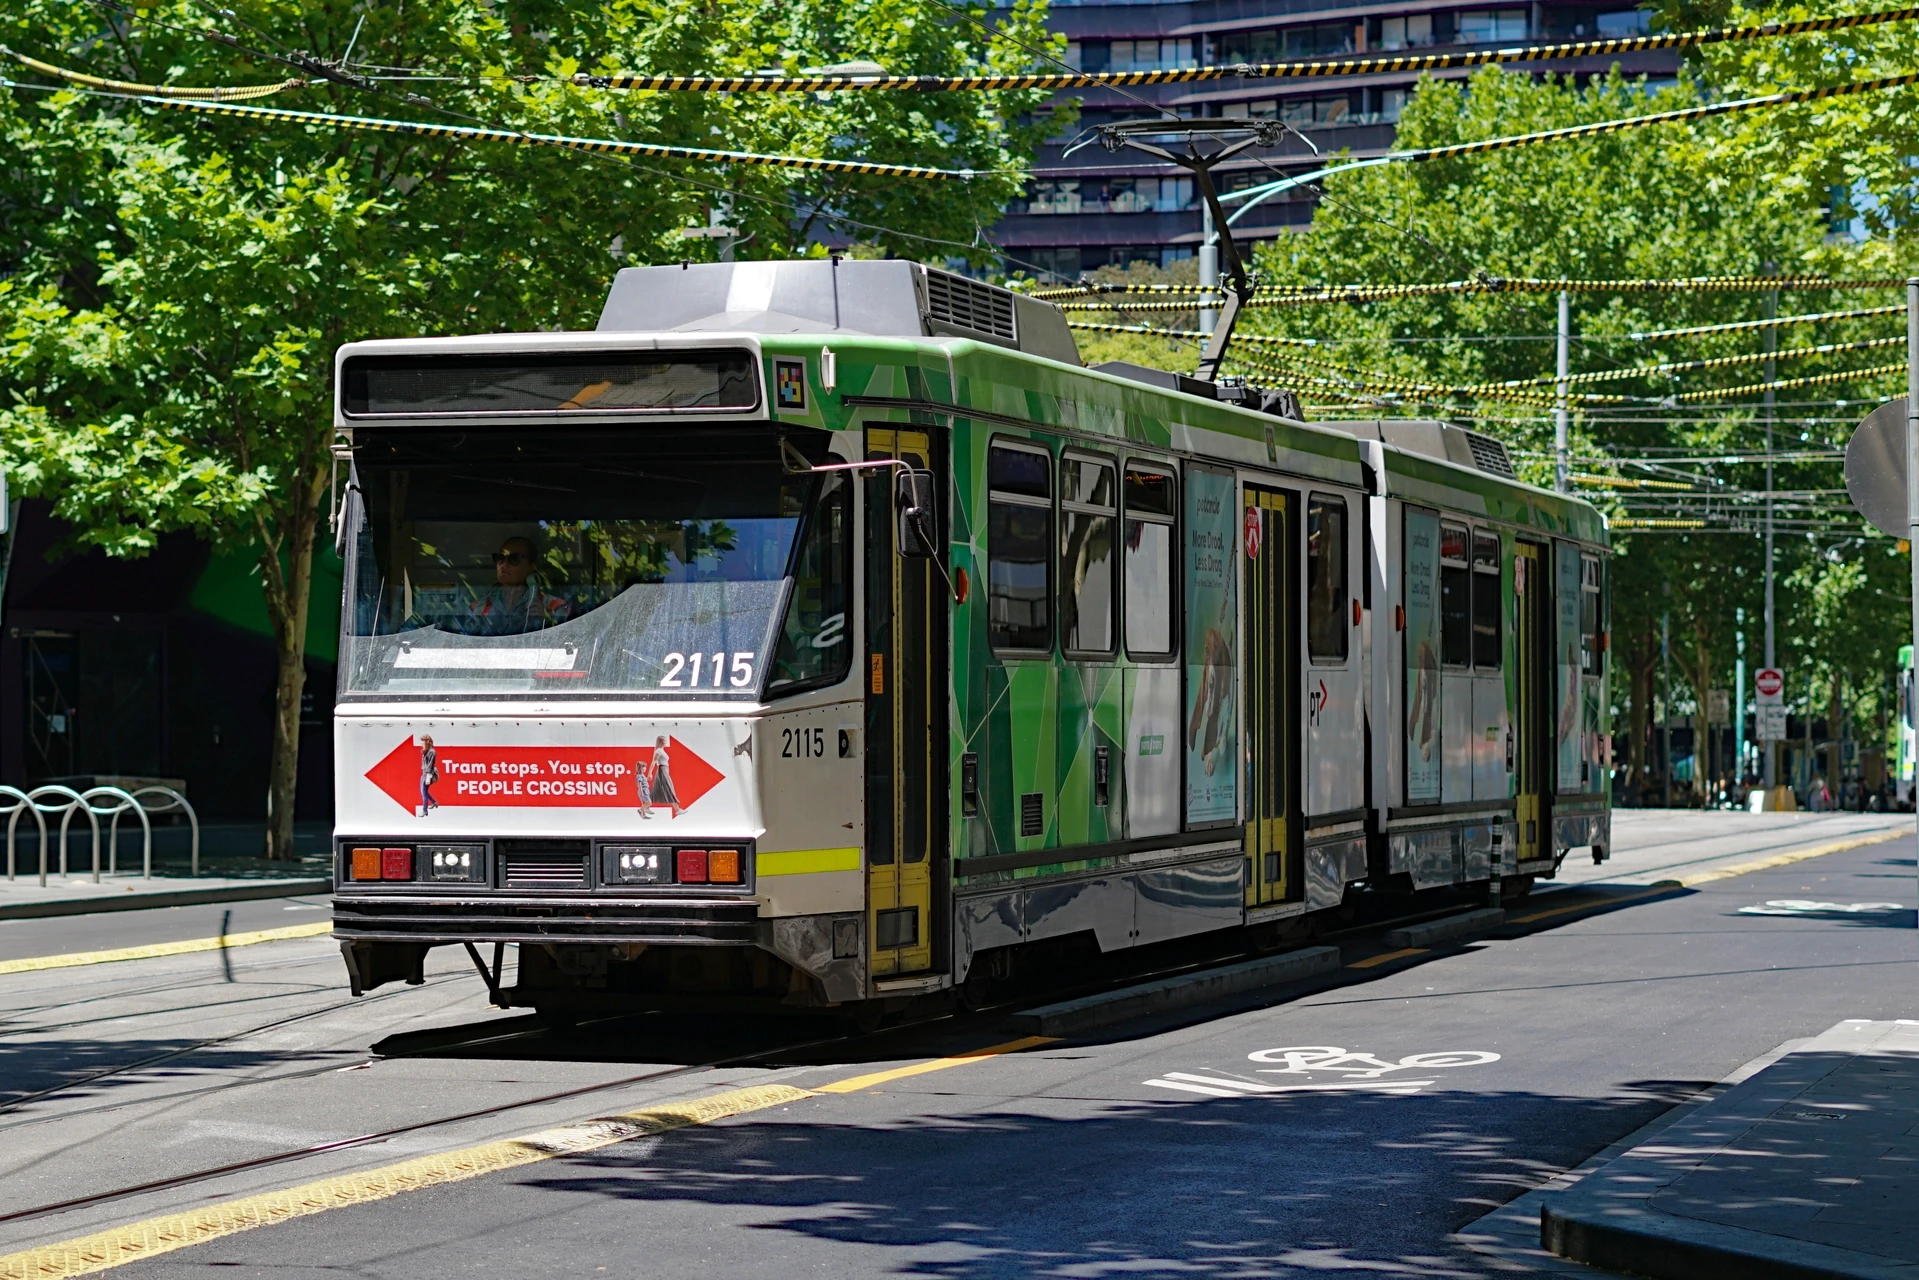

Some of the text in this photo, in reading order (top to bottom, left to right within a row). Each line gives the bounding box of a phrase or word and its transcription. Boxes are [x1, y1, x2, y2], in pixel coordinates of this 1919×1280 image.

[1248, 514, 1257, 526] STOP
[1193, 530, 1224, 552] More Drool,
[1195, 553, 1222, 577] Less Drag
[659, 652, 755, 687] 2115
[782, 727, 824, 758] 2115
[1152, 739, 1162, 750] trams
[442, 759, 632, 778] Tram stops. You stop.
[457, 780, 618, 796] PEOPLE CROSSING
